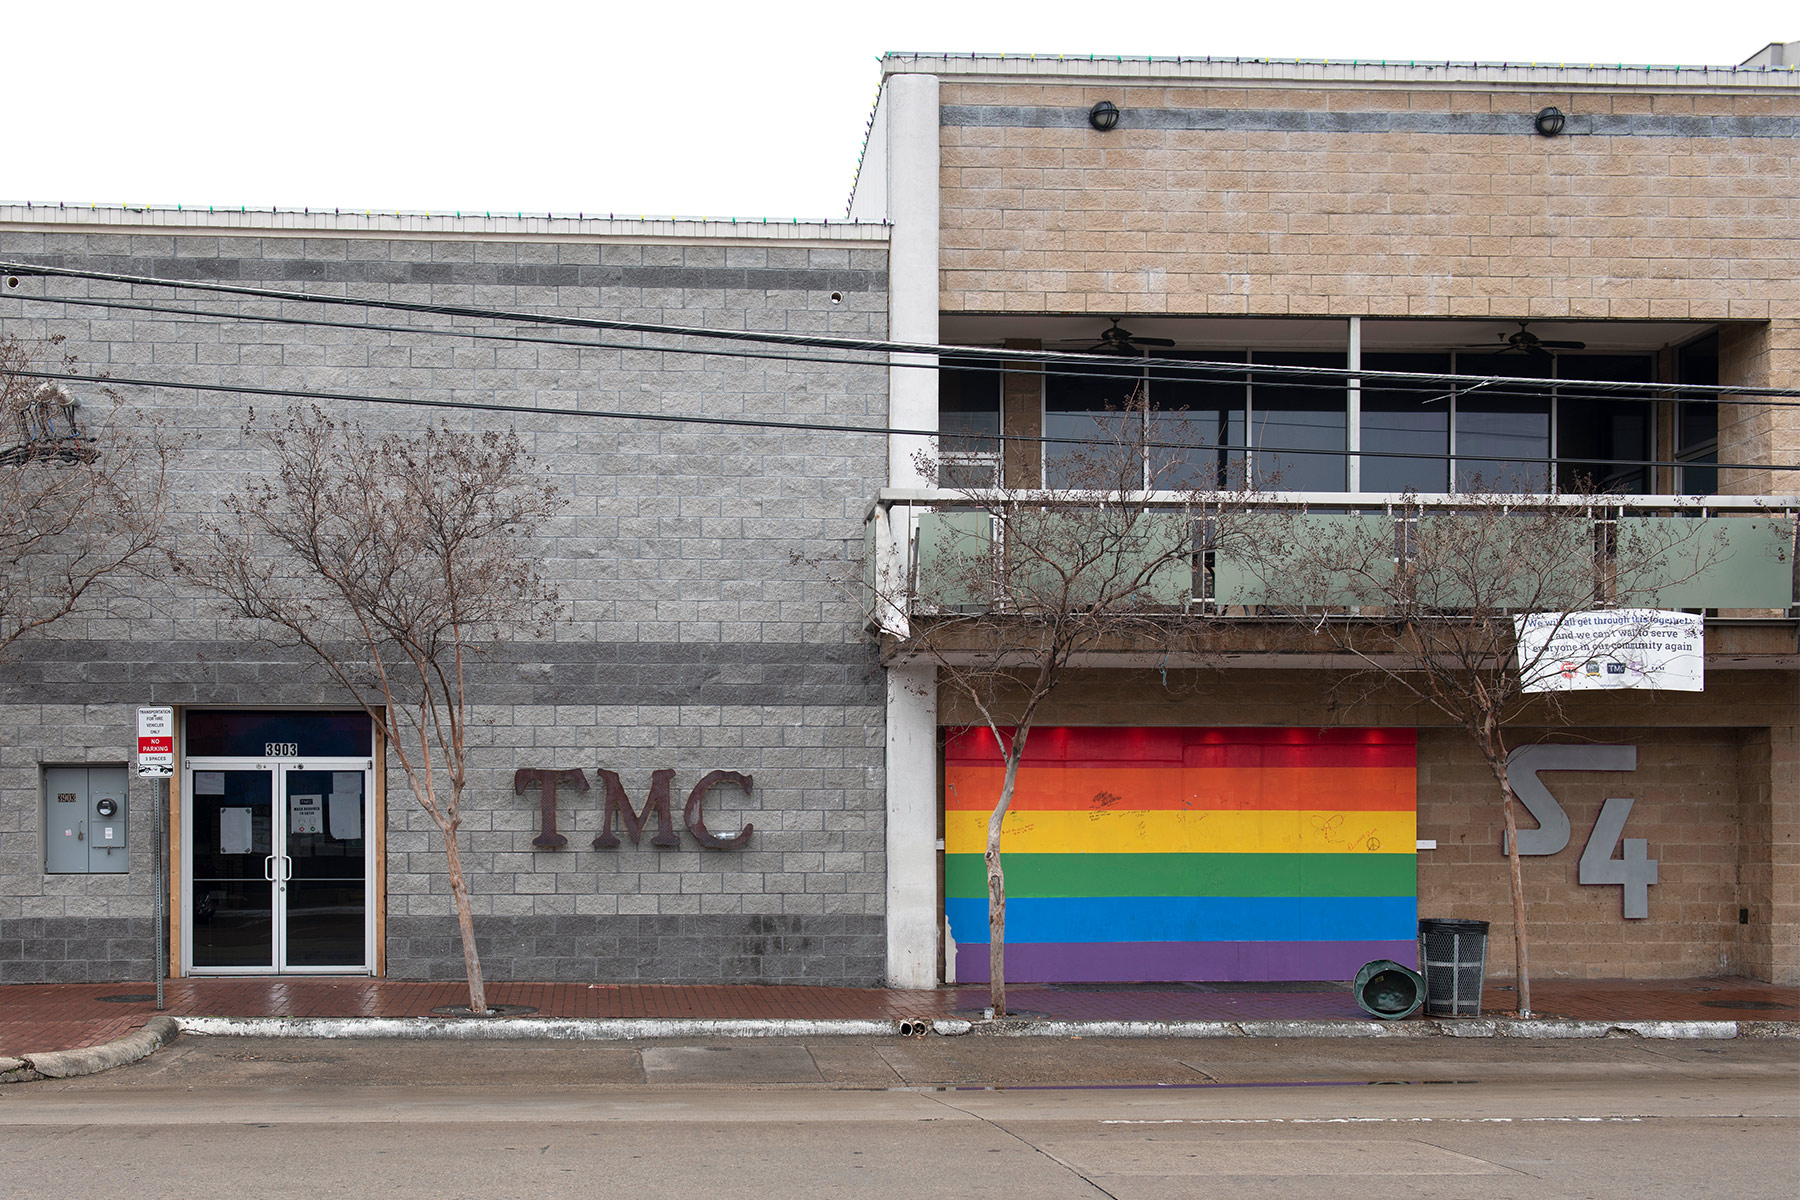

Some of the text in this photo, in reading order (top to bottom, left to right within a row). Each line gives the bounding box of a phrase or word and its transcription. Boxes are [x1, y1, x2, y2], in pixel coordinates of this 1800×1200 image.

[1528, 619, 1543, 627] We
[1545, 618, 1561, 626] wil
[1564, 617, 1575, 626] all
[1577, 617, 1592, 627] get
[1594, 616, 1630, 626] through
[1555, 631, 1574, 639] and
[1593, 630, 1616, 638] can't
[1618, 629, 1638, 637] wai
[1650, 630, 1678, 638] serve
[1611, 641, 1662, 652] community
[1665, 641, 1693, 652] again
[266, 743, 297, 756] 3903
[58, 793, 76, 802] 3903
[514, 767, 754, 849] TMC
[1503, 744, 1658, 919] S4
